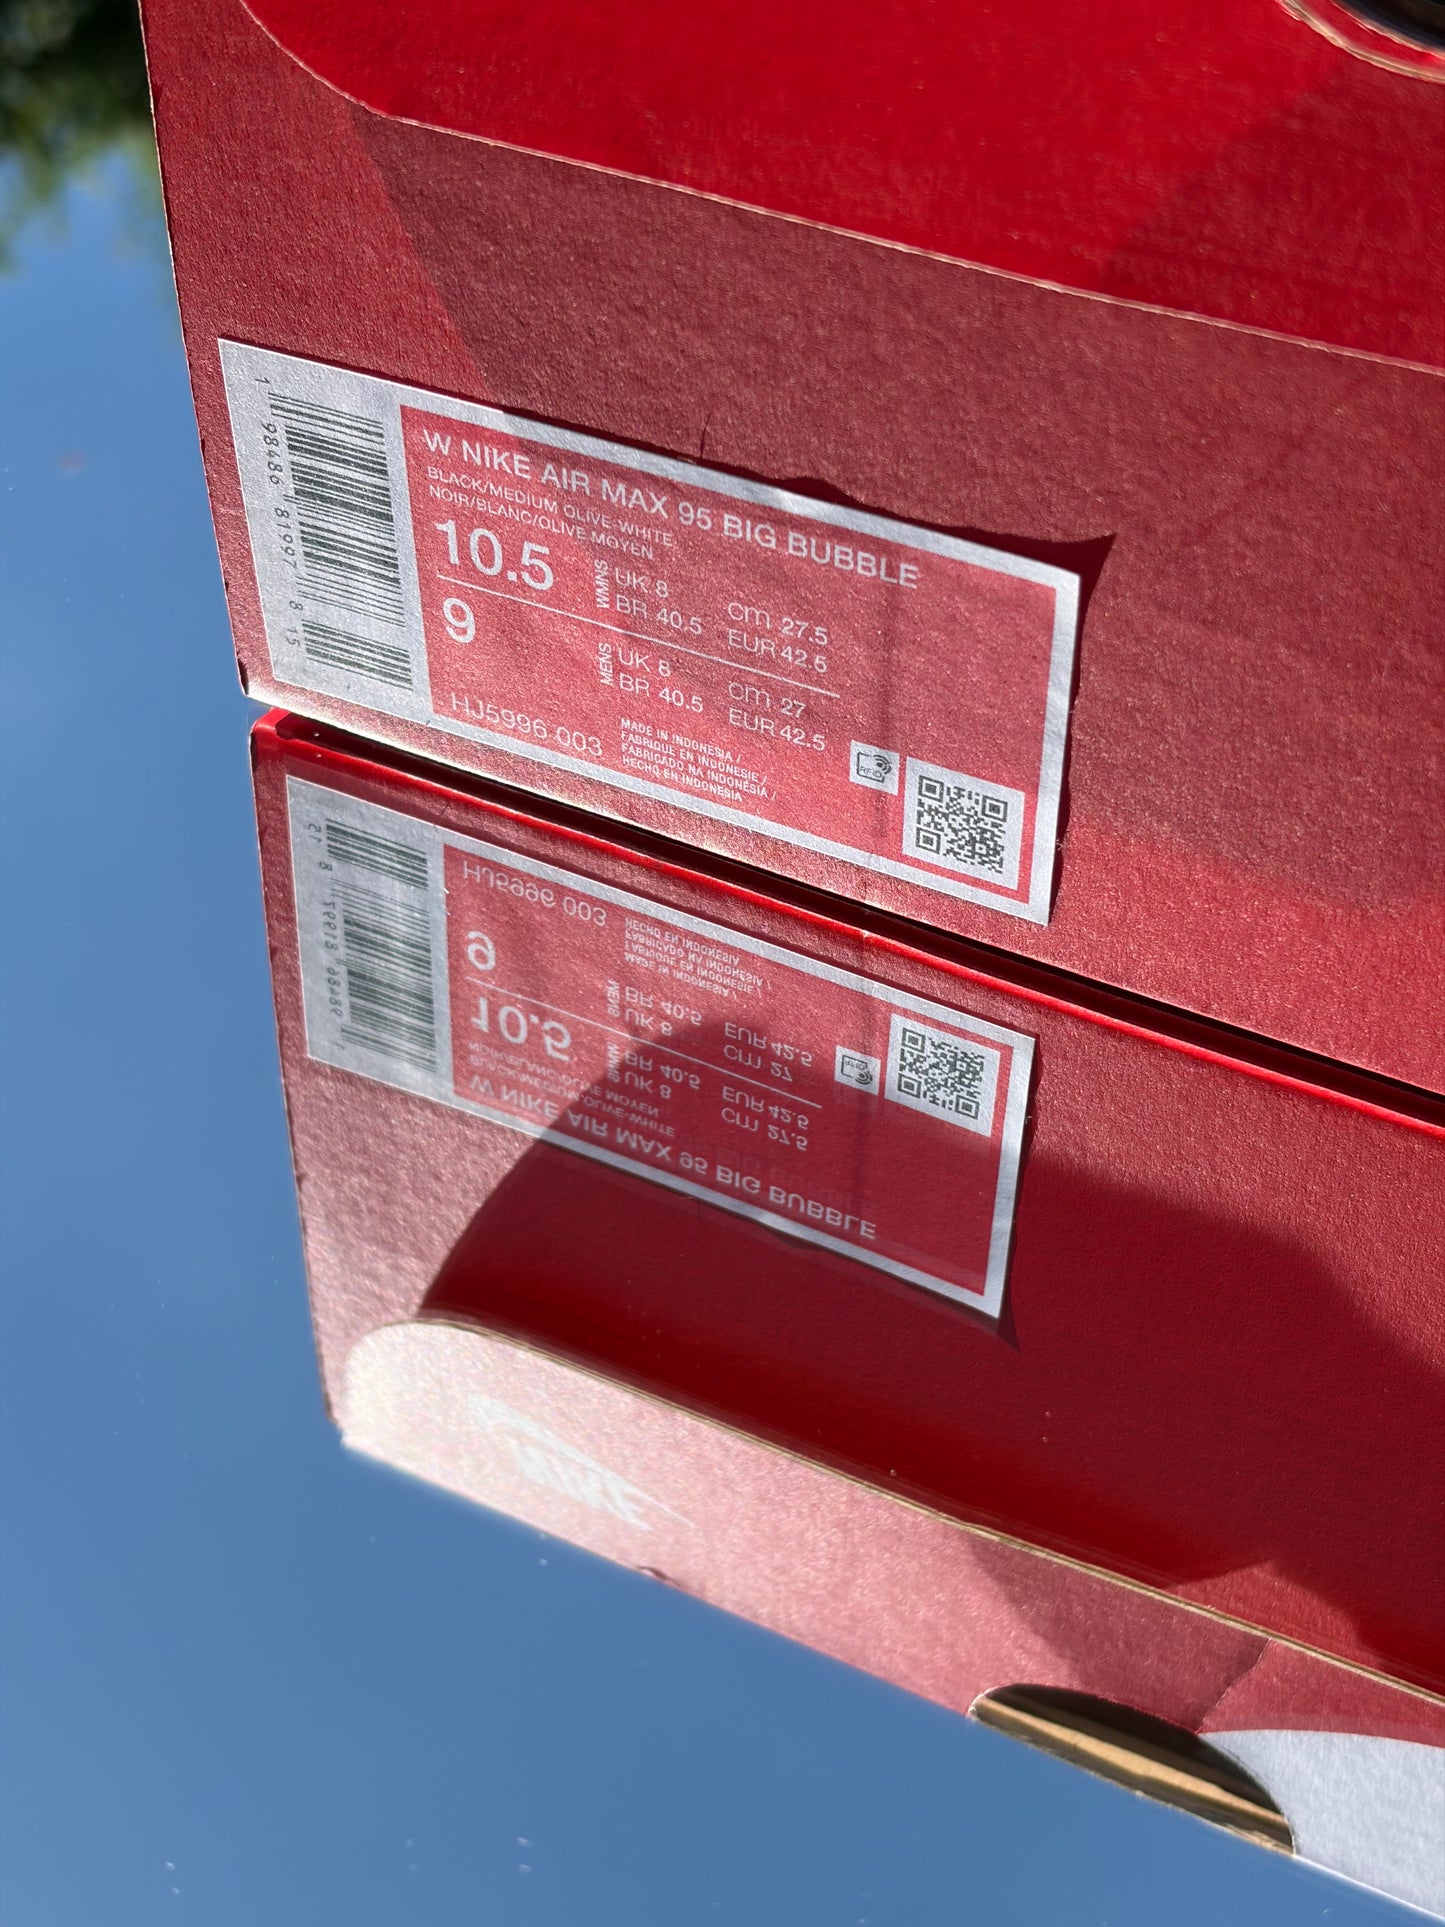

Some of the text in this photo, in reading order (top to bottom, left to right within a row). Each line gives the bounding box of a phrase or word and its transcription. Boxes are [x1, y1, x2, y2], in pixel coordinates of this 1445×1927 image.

[261, 422, 284, 486] 98486
[423, 429, 920, 590] W NIKE AIR MAX 95 BIG BUBBLE
[427, 466, 674, 547] BLACK/MEDIUM OLIVE-WHITE
[429, 485, 653, 560] NOIR/BLANC/OLIVE MOYEN
[274, 507, 298, 570] 81997
[434, 519, 554, 590] 10.5
[594, 560, 609, 609] WMNS
[615, 567, 669, 598] UK 8
[289, 600, 304, 612] 8
[441, 597, 476, 644] 9
[615, 594, 702, 635] BR 40.5
[727, 602, 828, 646] cm 27.5
[287, 627, 301, 648] 15
[727, 628, 828, 673] EUR 42.5
[598, 642, 613, 686] MENS
[617, 649, 671, 677] UK 8
[618, 673, 703, 713] BR 40.5
[727, 682, 806, 718] cm 27
[451, 693, 602, 757] HJ5996 003
[621, 718, 653, 736] MADE
[656, 729, 669, 741] IN
[672, 734, 733, 762] INDONESIA
[728, 708, 826, 752] EUR 42.5
[621, 730, 676, 756] FABRIQUE
[680, 748, 694, 762] EN
[698, 754, 760, 782] INDONESIE
[621, 743, 684, 771] FABRICADO
[688, 764, 704, 778] NA
[859, 765, 883, 778] RFID
[622, 755, 743, 802] HECHO EN INDONESIA
